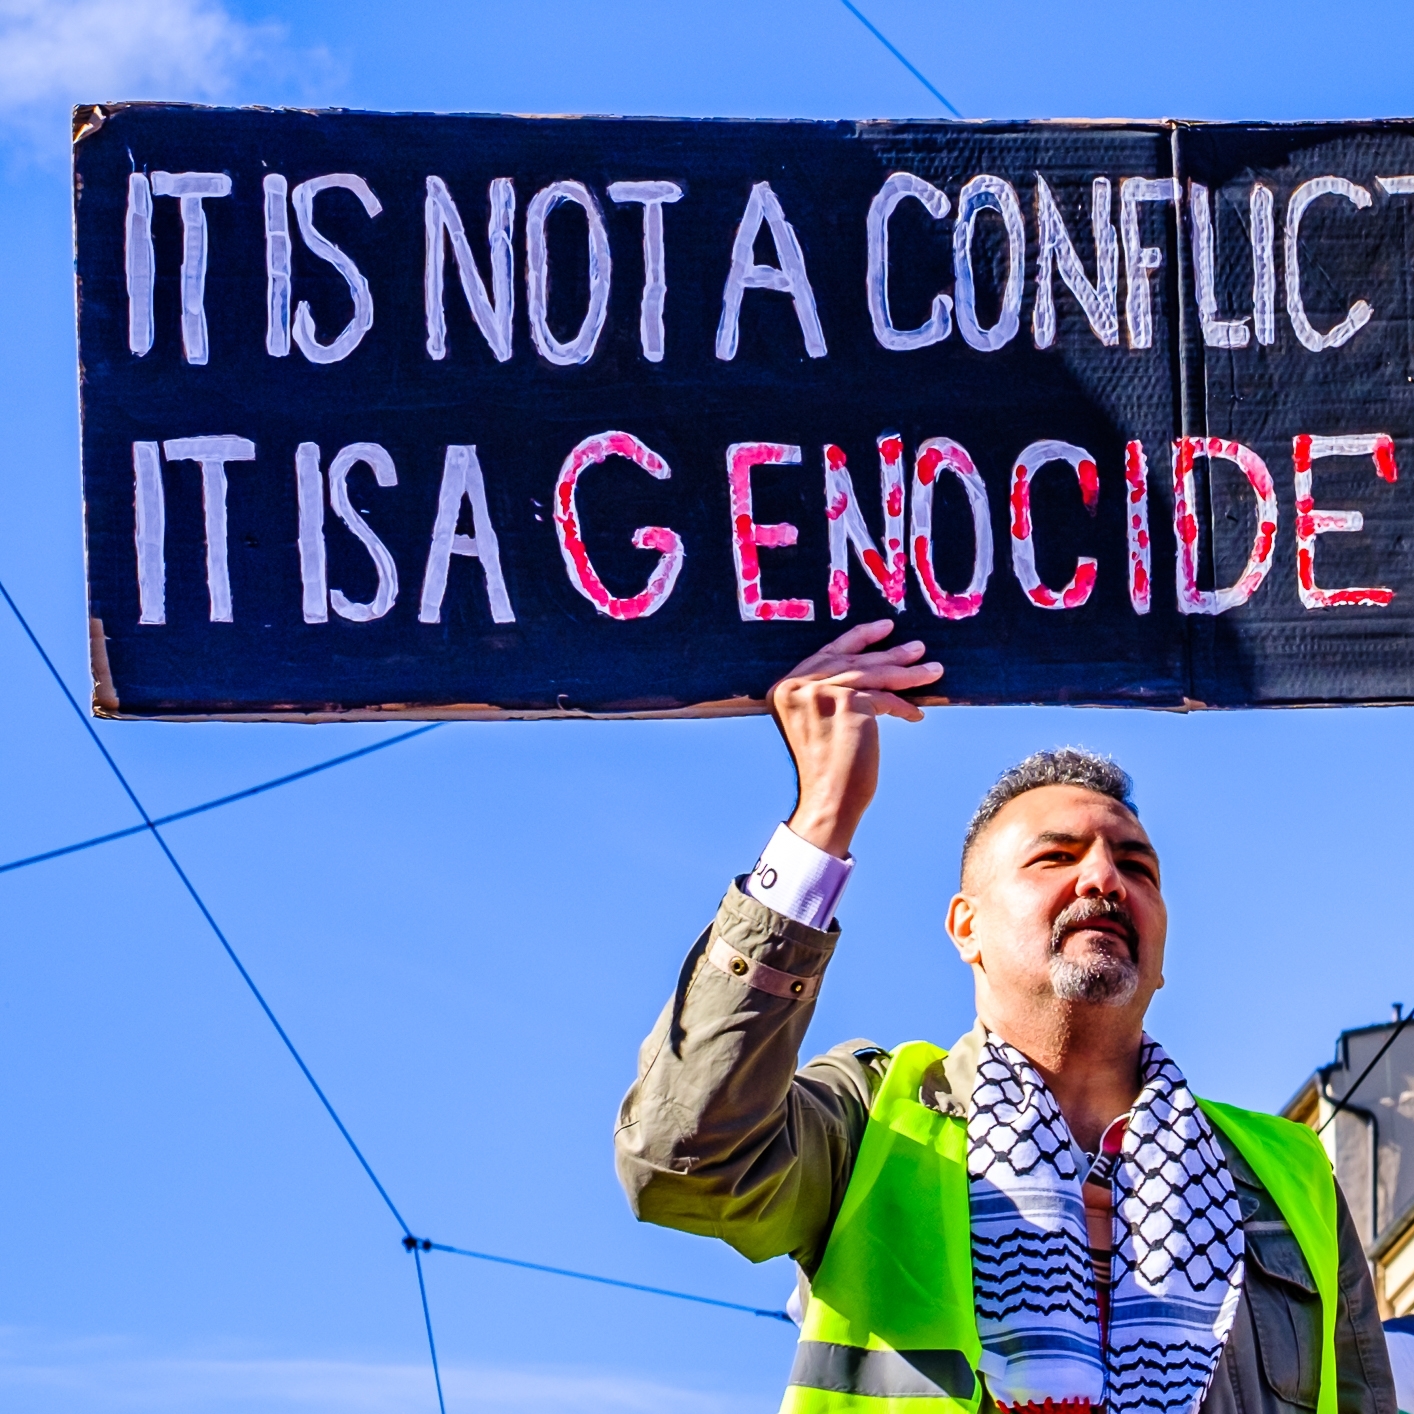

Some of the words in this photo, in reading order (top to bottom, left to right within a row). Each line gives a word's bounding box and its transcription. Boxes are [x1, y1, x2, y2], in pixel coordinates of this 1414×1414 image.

[125, 171, 232, 365] IT
[263, 173, 383, 364] IS
[424, 176, 685, 366] NOT
[715, 180, 828, 361] A
[132, 435, 256, 625] IT
[295, 441, 398, 624] IS
[418, 444, 516, 623] A
[553, 430, 1397, 622] GENOCIDE
